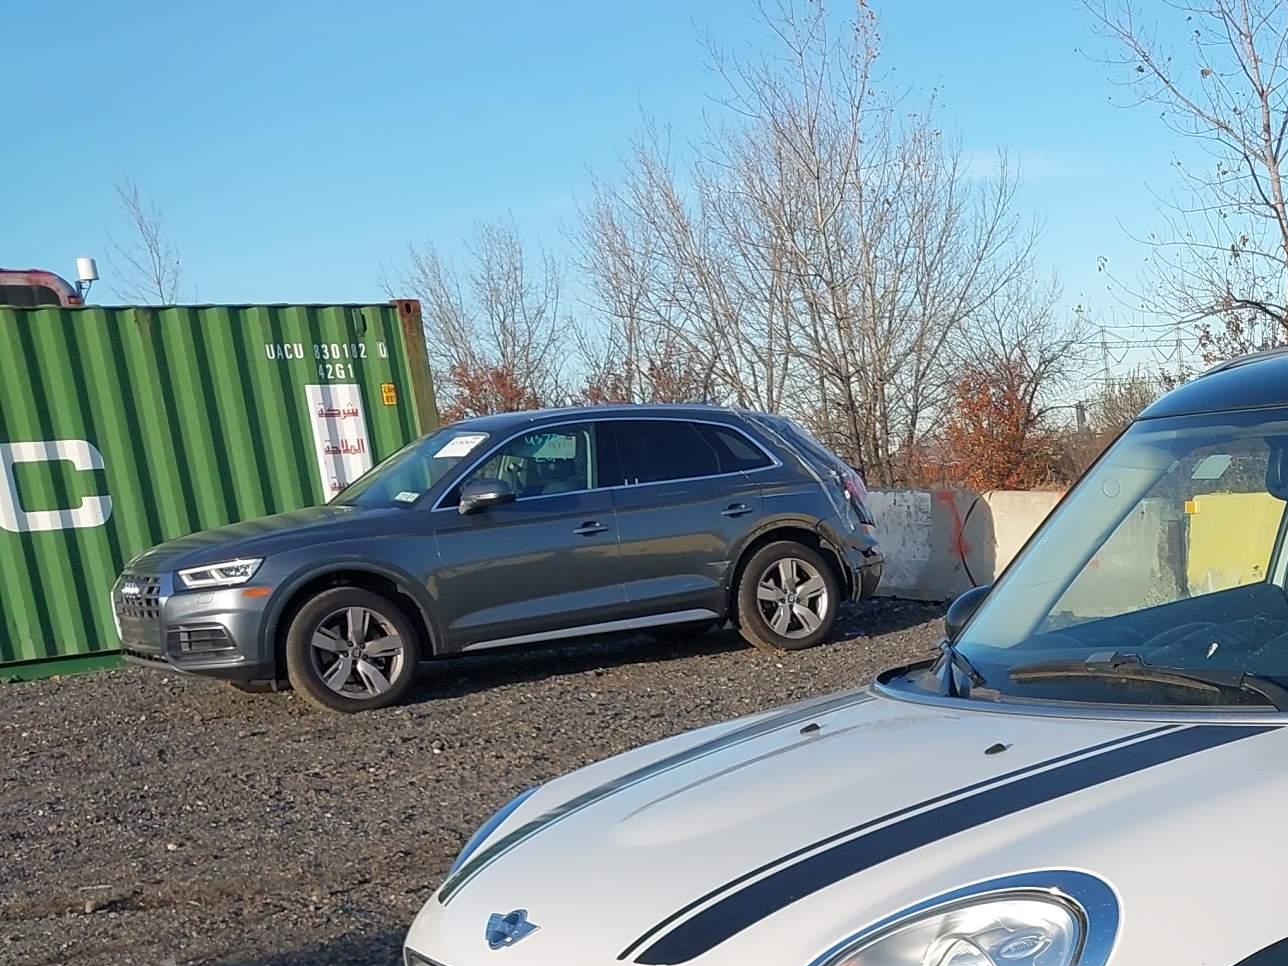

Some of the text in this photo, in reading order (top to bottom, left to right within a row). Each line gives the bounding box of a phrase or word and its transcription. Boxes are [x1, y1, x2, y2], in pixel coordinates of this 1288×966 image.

[265, 343, 304, 359] UACU
[314, 343, 367, 358] 830182
[318, 363, 354, 379] 42G1
